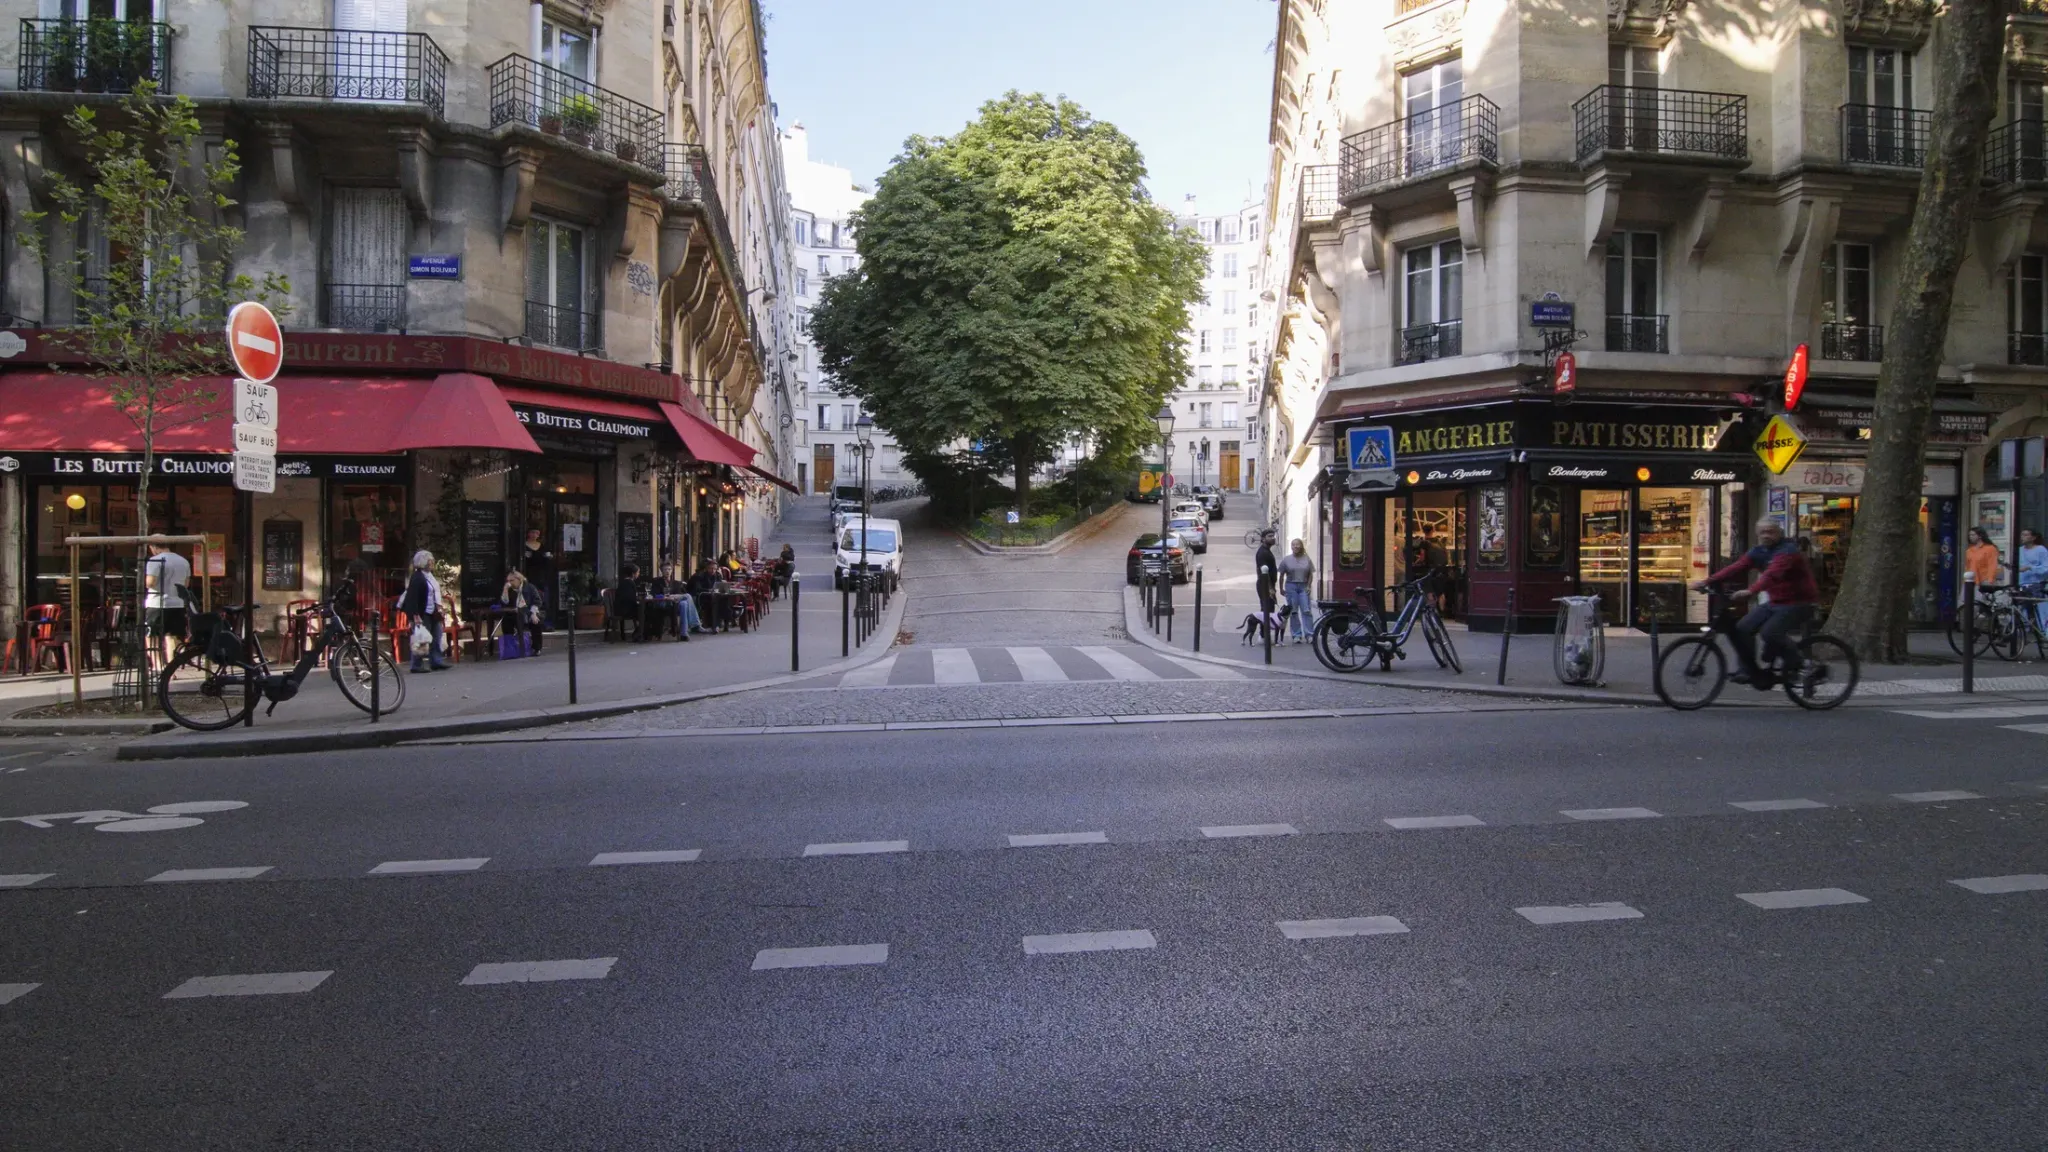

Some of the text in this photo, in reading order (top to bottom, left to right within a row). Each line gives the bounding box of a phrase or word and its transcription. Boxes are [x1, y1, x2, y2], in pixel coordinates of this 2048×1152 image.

[284, 340, 397, 364] aurant
[473, 344, 674, 401] Les Buttes Chaumont
[1785, 353, 1802, 402] TABAC
[246, 384, 268, 398] SAUF
[516, 411, 650, 437] ES BUTTES CHAUMONT
[239, 433, 275, 447] SAUF BUS
[1552, 421, 1719, 449] PATISSERIE
[1756, 437, 1794, 451] PRESSE
[54, 458, 84, 473] LES
[161, 458, 234, 474] CHAUMO
[239, 456, 260, 464] INTERDIT
[335, 464, 396, 474] RESTAURANT
[1426, 468, 1492, 480] Des Pyrénées
[1548, 465, 1607, 479] Boulangerie
[1803, 468, 1856, 487] tabac
